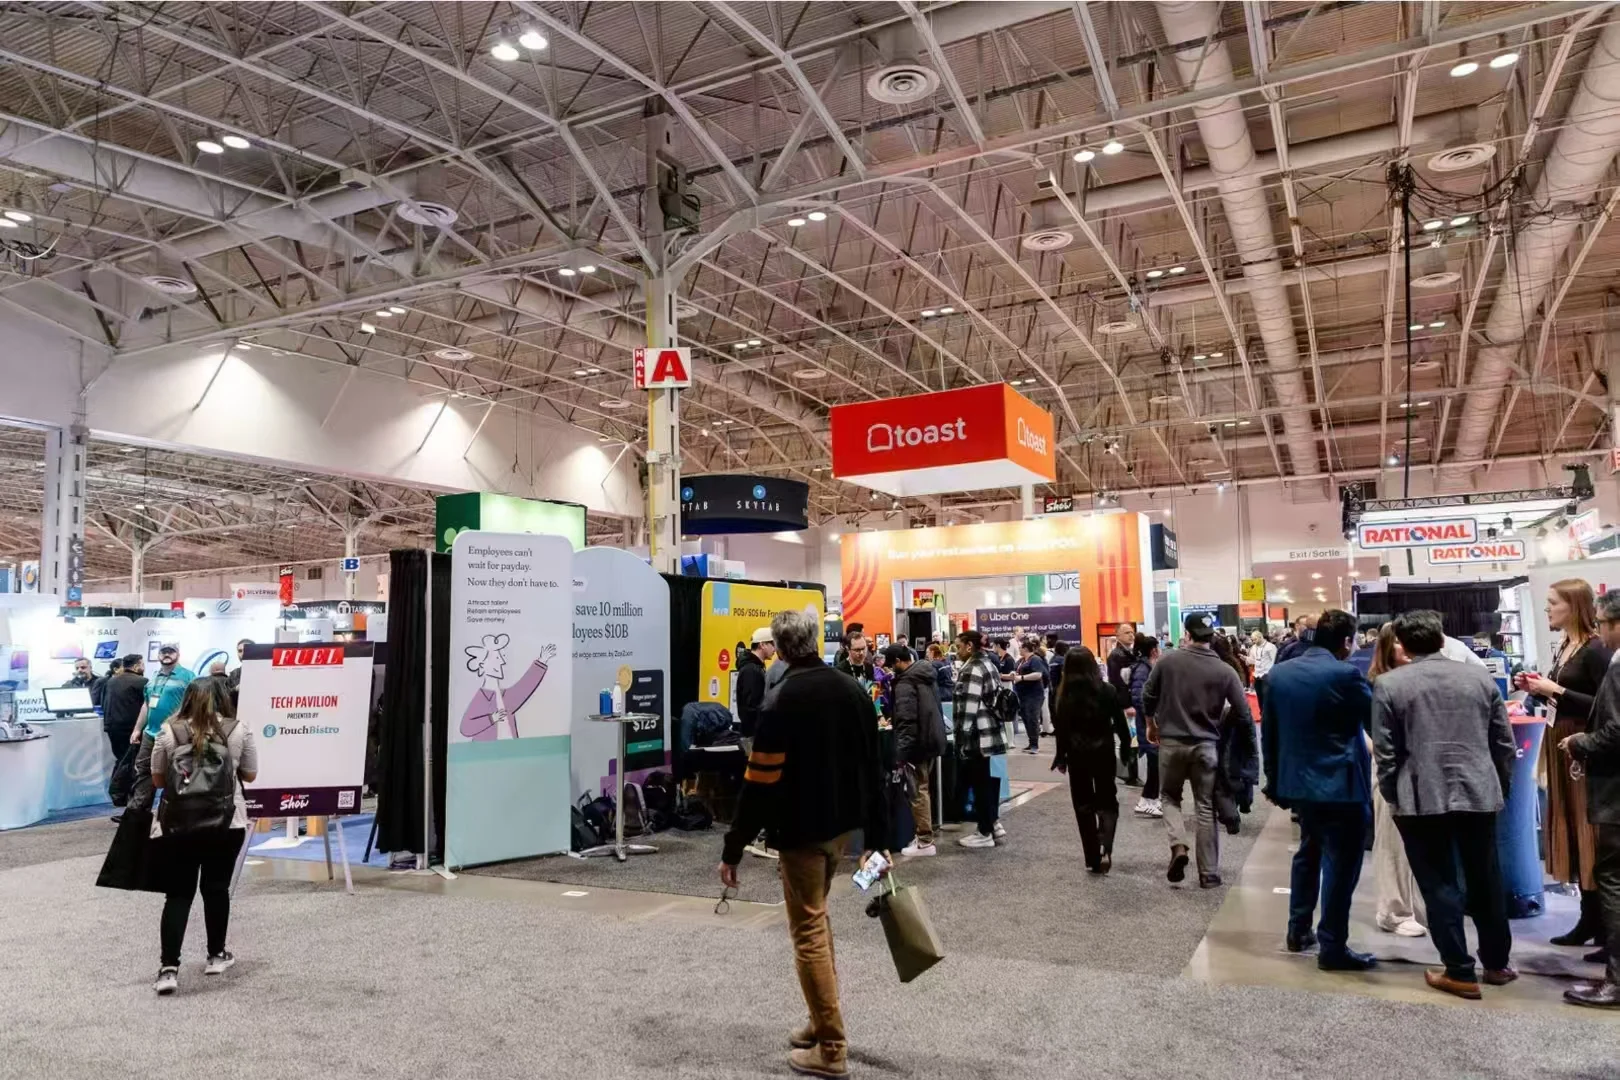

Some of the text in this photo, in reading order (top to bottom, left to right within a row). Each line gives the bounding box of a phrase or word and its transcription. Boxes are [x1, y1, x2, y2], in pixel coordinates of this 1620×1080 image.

[635, 350, 644, 387] HALL
[651, 350, 689, 381] A
[894, 417, 967, 447] toast
[1025, 426, 1047, 456] toast
[736, 501, 780, 512] SKYTAB
[1365, 524, 1471, 543] RATIONAL
[468, 545, 532, 557] Employees can't
[1433, 544, 1520, 560] RATIONAL
[345, 559, 359, 569] B
[468, 561, 531, 572] wait for payday.
[467, 577, 559, 588] Now they don't have to.
[575, 601, 643, 616] save 10 million
[989, 612, 1029, 621] Uber One
[604, 623, 629, 639] $10B
[278, 648, 339, 665] FUEL
[271, 695, 338, 709] TECH PAVILION
[279, 725, 340, 736] TouchBistro
[280, 795, 309, 810] Show
